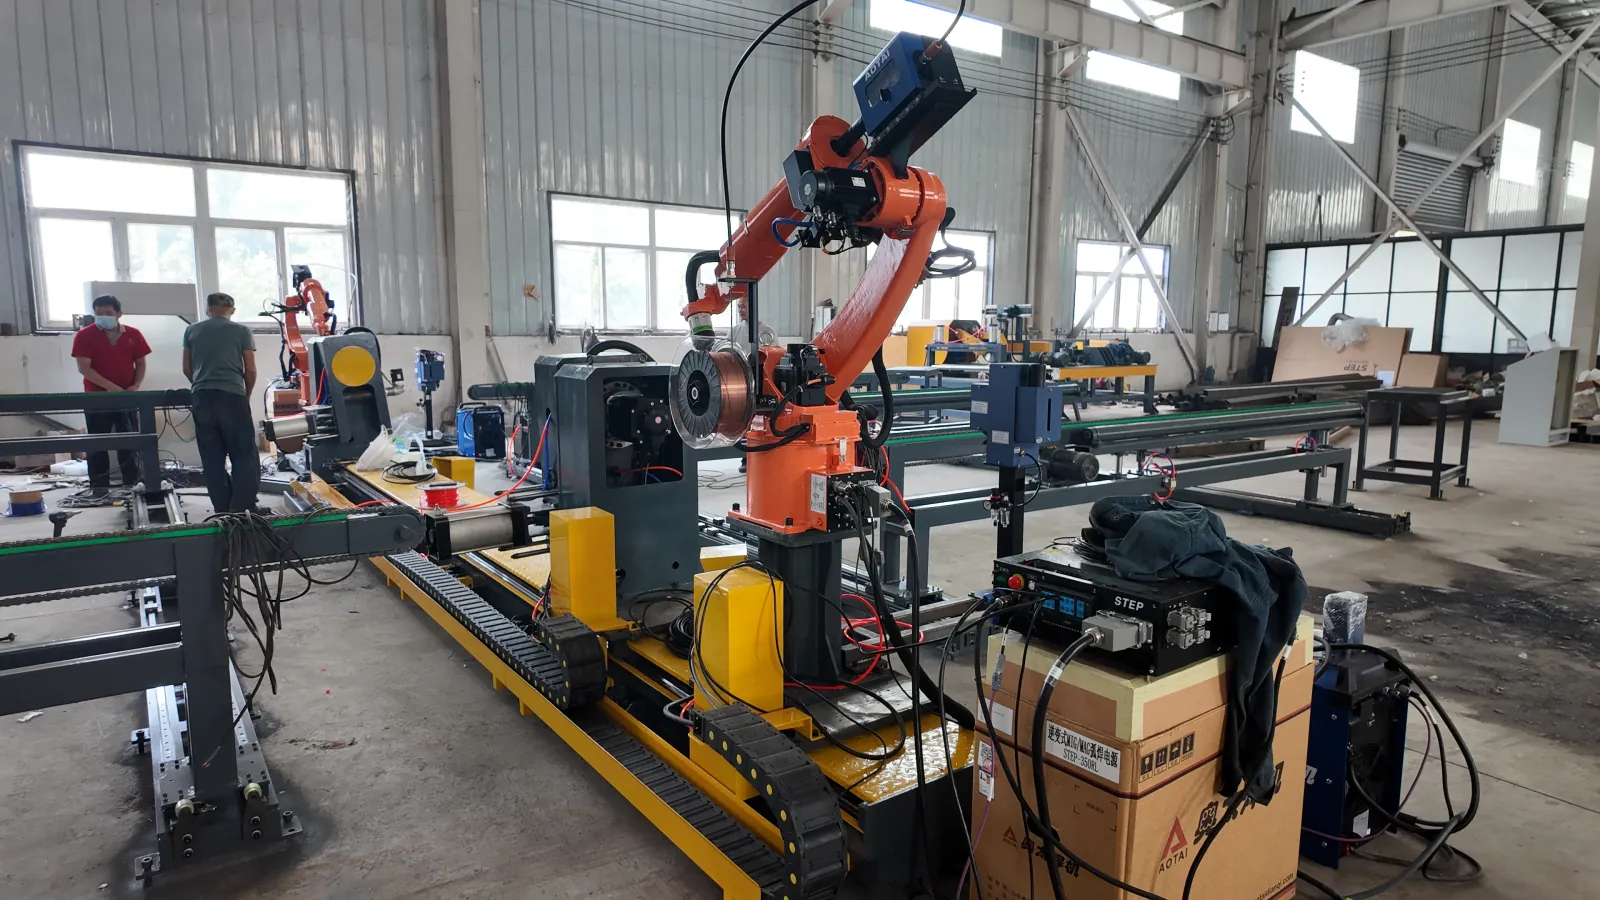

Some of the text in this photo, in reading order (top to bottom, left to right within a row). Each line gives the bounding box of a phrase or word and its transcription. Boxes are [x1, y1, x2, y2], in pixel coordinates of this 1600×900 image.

[865, 48, 891, 81] AOTAI
[1114, 596, 1144, 611] STEP
[1048, 724, 1118, 768] 逆变式MIG/MAG弧焊电源
[1063, 748, 1099, 773] STEP-350RL
[1158, 848, 1188, 874] AOTAI
